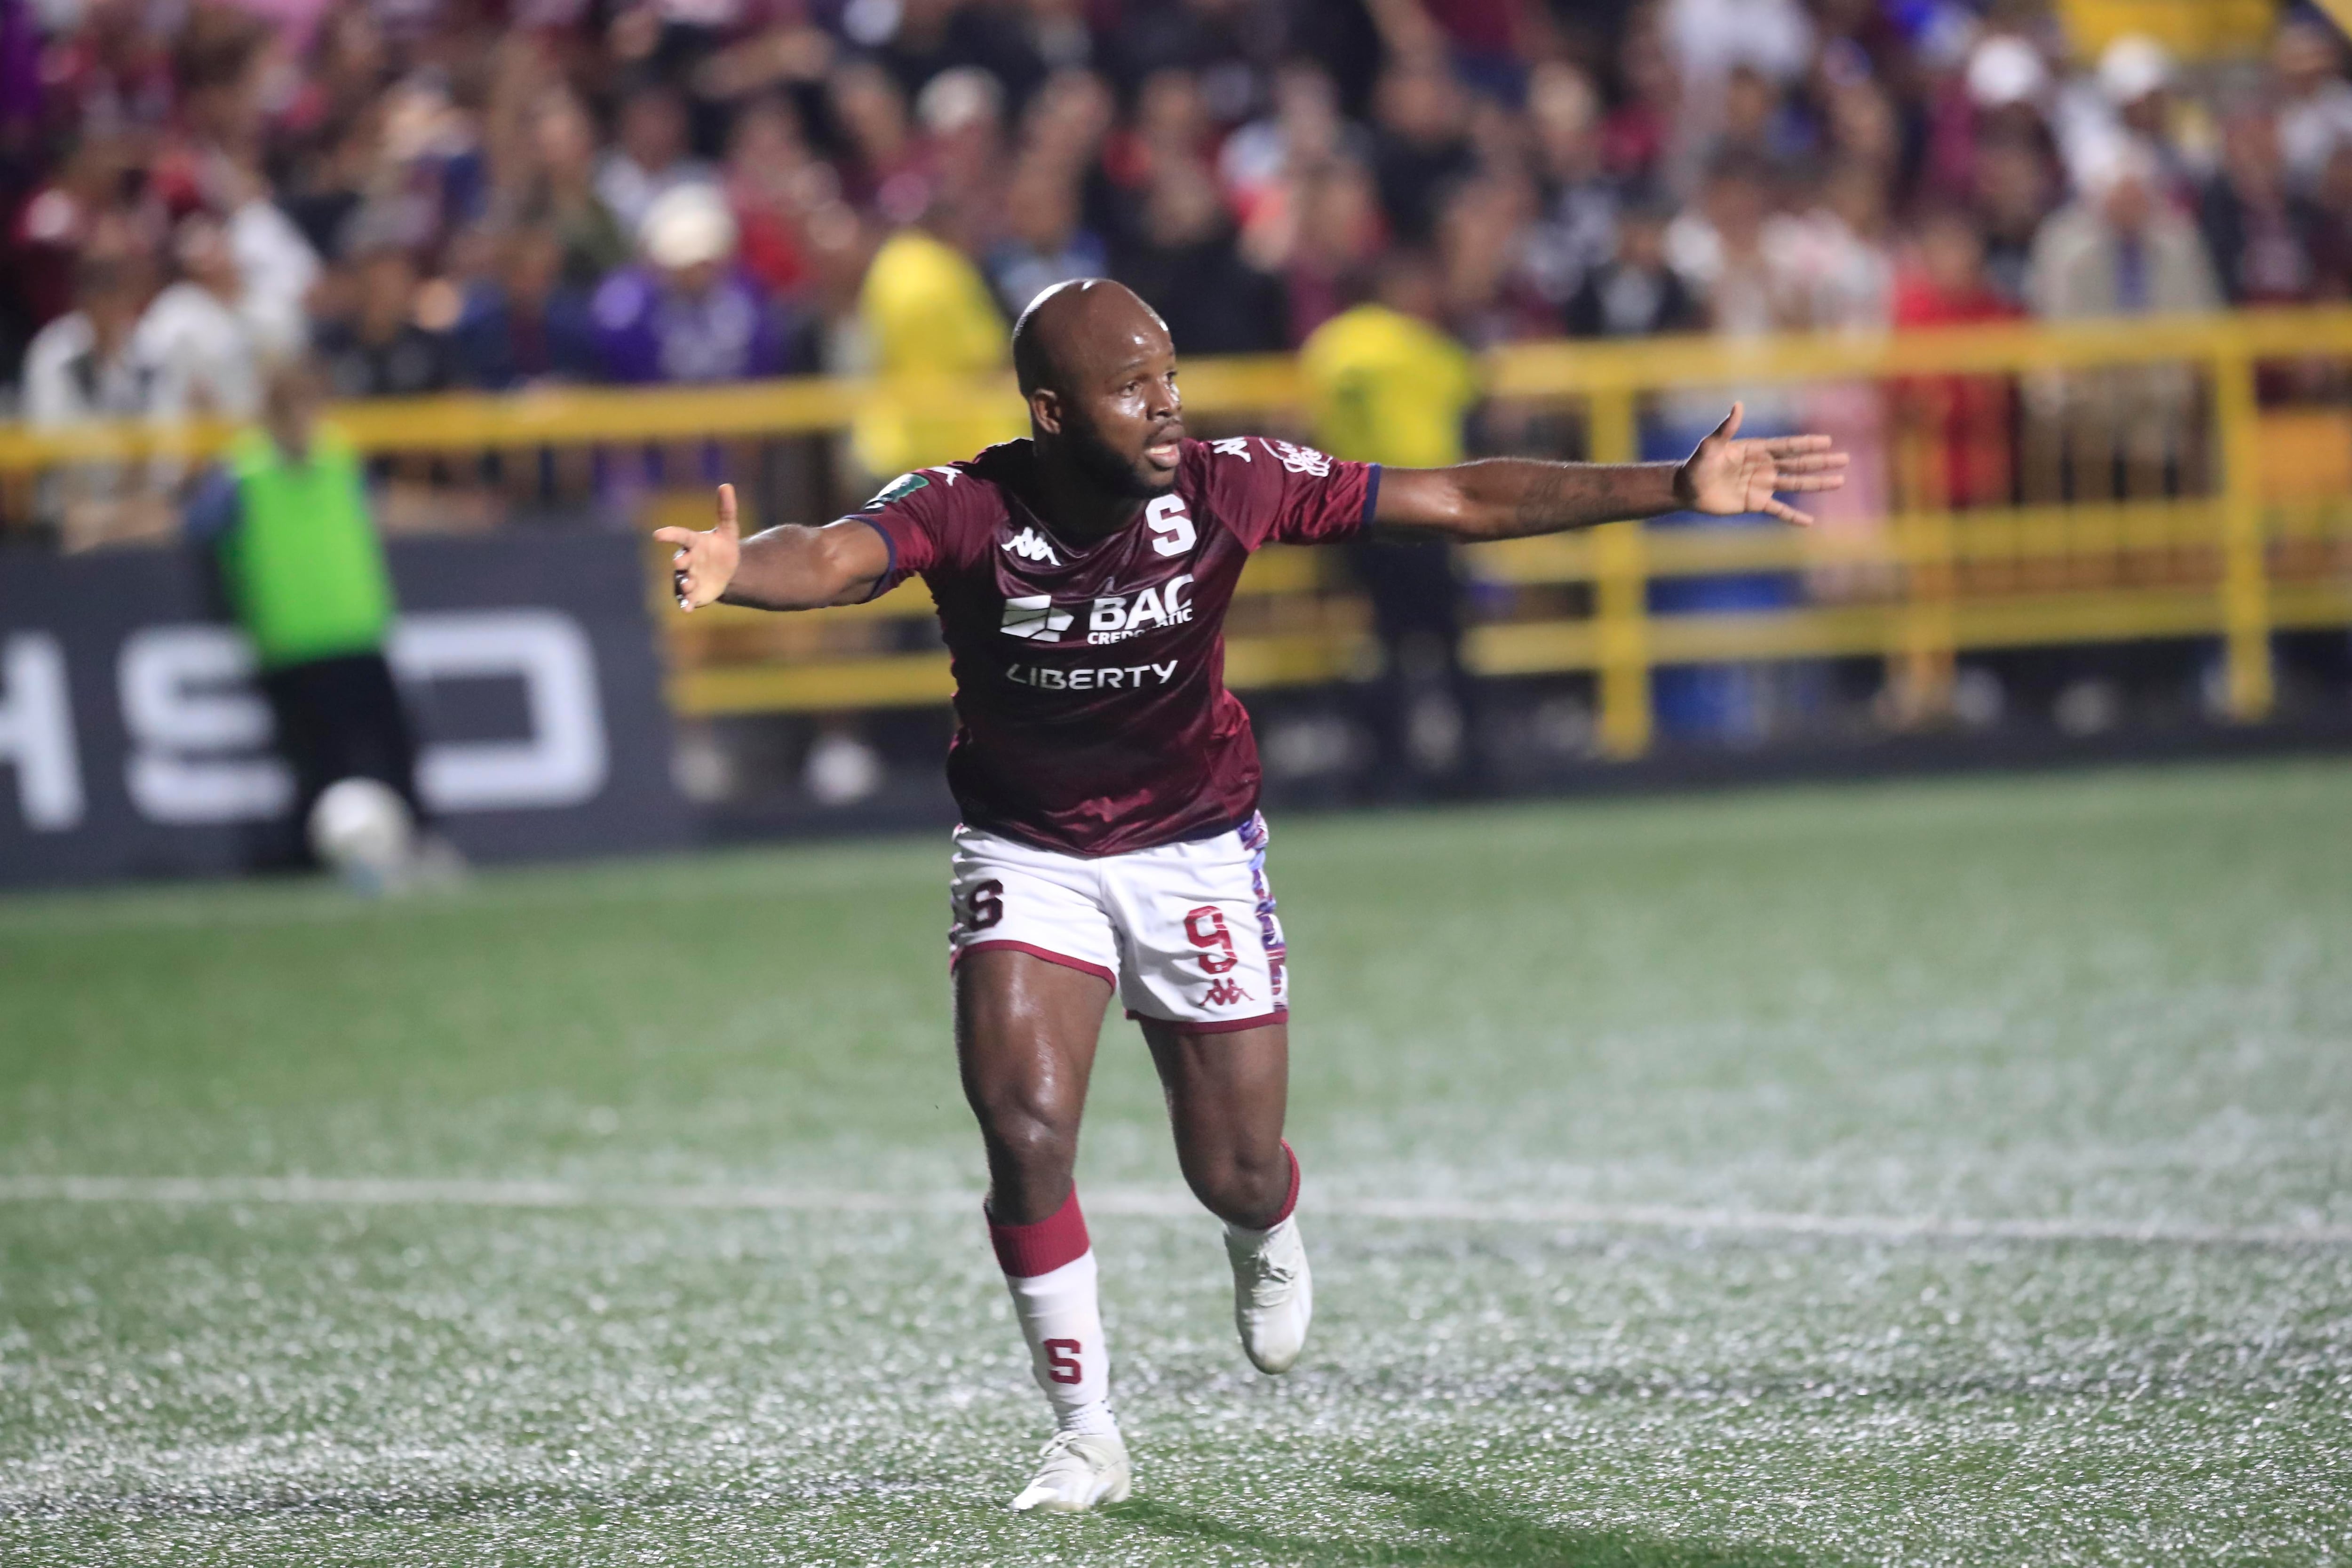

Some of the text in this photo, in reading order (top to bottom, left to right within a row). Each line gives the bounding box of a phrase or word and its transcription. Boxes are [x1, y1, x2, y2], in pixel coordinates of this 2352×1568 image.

[1145, 494, 1197, 557] S
[1089, 573, 1194, 631] BAC
[1006, 660, 1178, 690] LIBERTY
[969, 879, 1003, 931] S
[1183, 905, 1239, 975] 9
[1043, 1338, 1081, 1385] S
